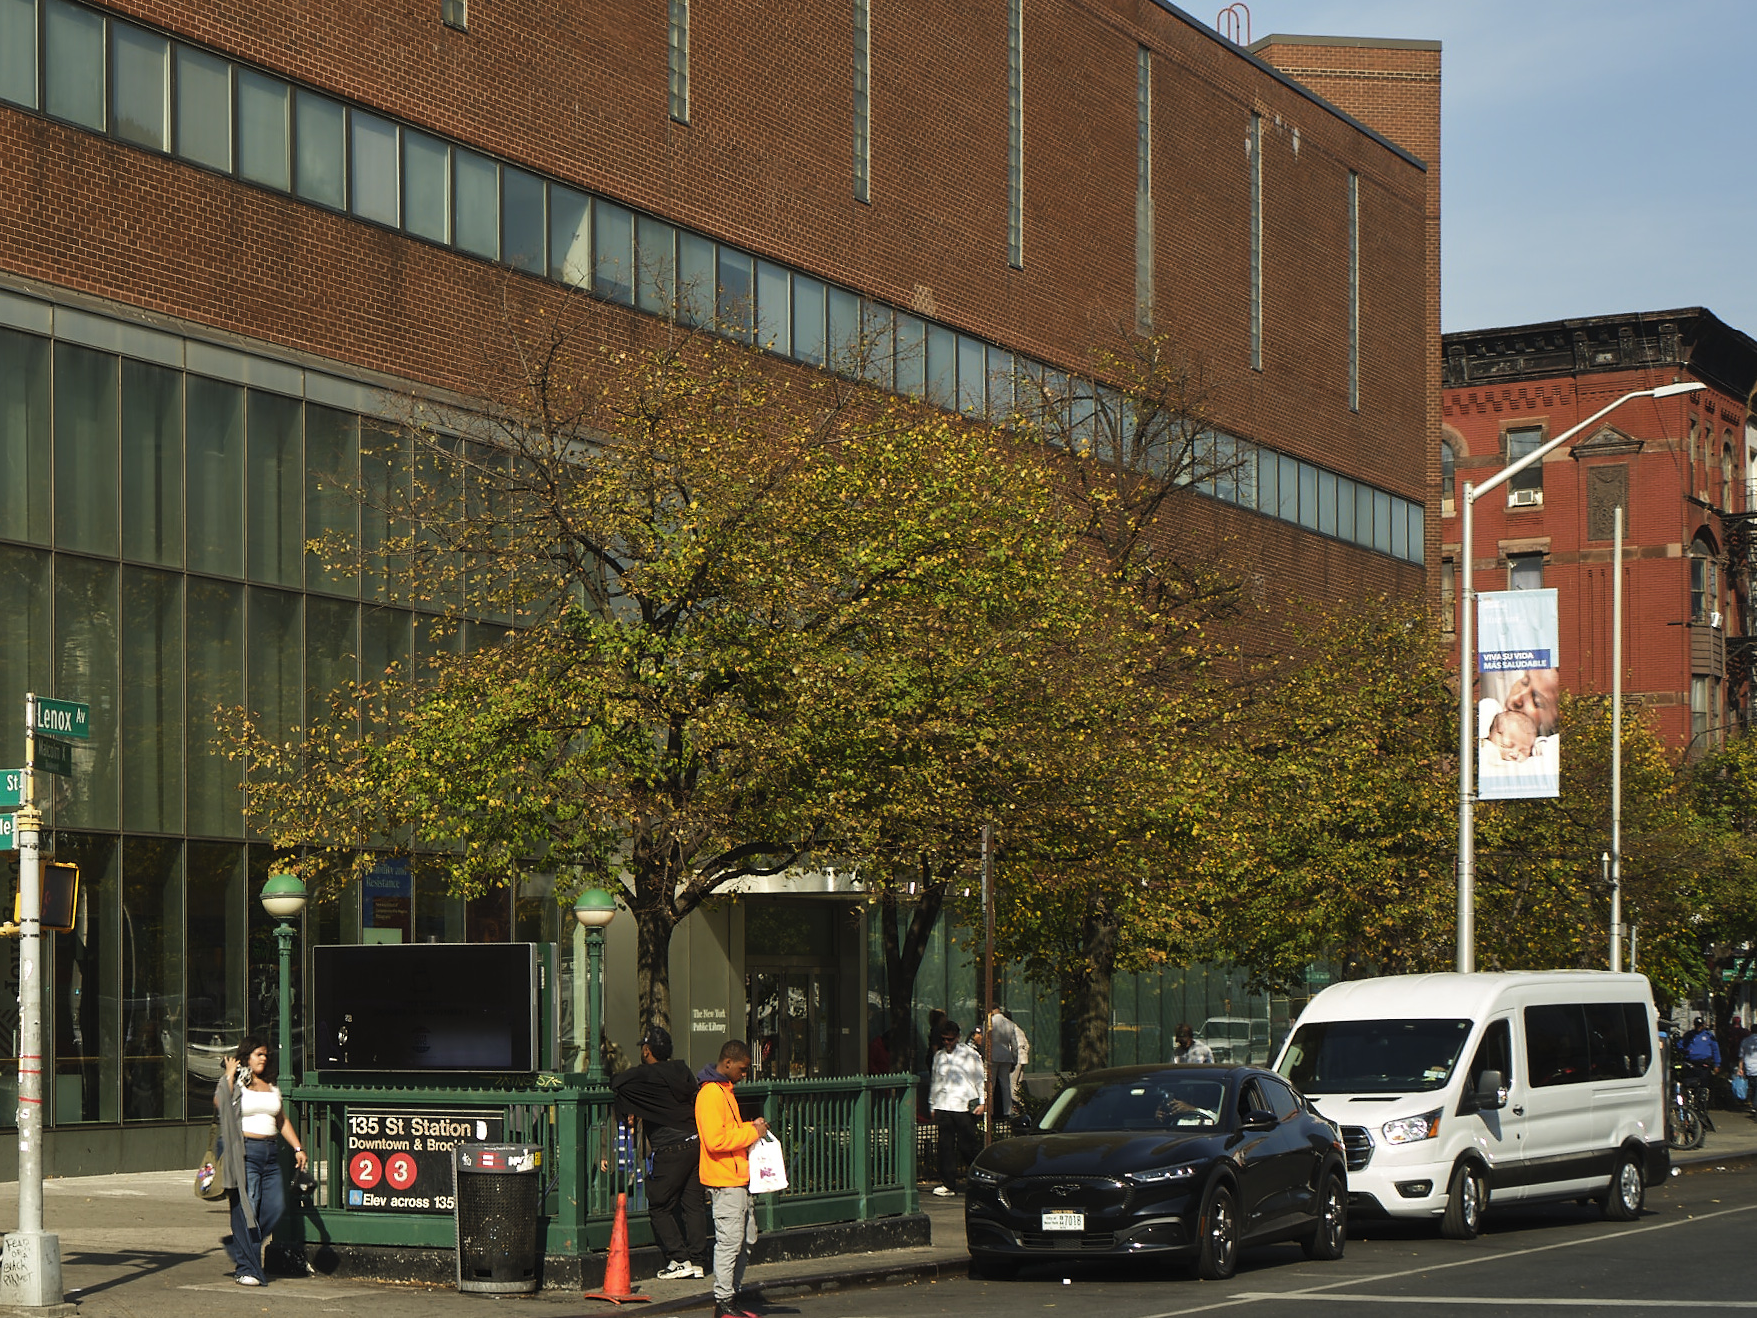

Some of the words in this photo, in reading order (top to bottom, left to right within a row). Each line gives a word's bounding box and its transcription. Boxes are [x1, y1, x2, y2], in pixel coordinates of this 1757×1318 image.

[1483, 653, 1502, 661] VIVA
[1502, 652, 1514, 661] SU
[1514, 651, 1534, 660] VIDA
[1502, 659, 1547, 669] SALUDABLE
[37, 702, 72, 732] Lenox
[75, 709, 86, 724] Av
[6, 775, 18, 791] St
[693, 1008, 703, 1019] The
[703, 1008, 714, 1019] New
[715, 1008, 726, 1019] York
[693, 1022, 708, 1032] Public
[708, 1022, 727, 1034] Library
[348, 1116, 380, 1135] 135
[385, 1117, 405, 1136] St
[410, 1117, 471, 1137] Station
[348, 1136, 410, 1151] Downtown
[413, 1138, 423, 1151] &
[359, 1159, 373, 1181] 2
[393, 1160, 409, 1182] 3
[362, 1193, 387, 1207] Elev
[390, 1196, 430, 1209] across
[433, 1195, 455, 1210] 135
[1064, 1215, 1082, 1226] 7018
